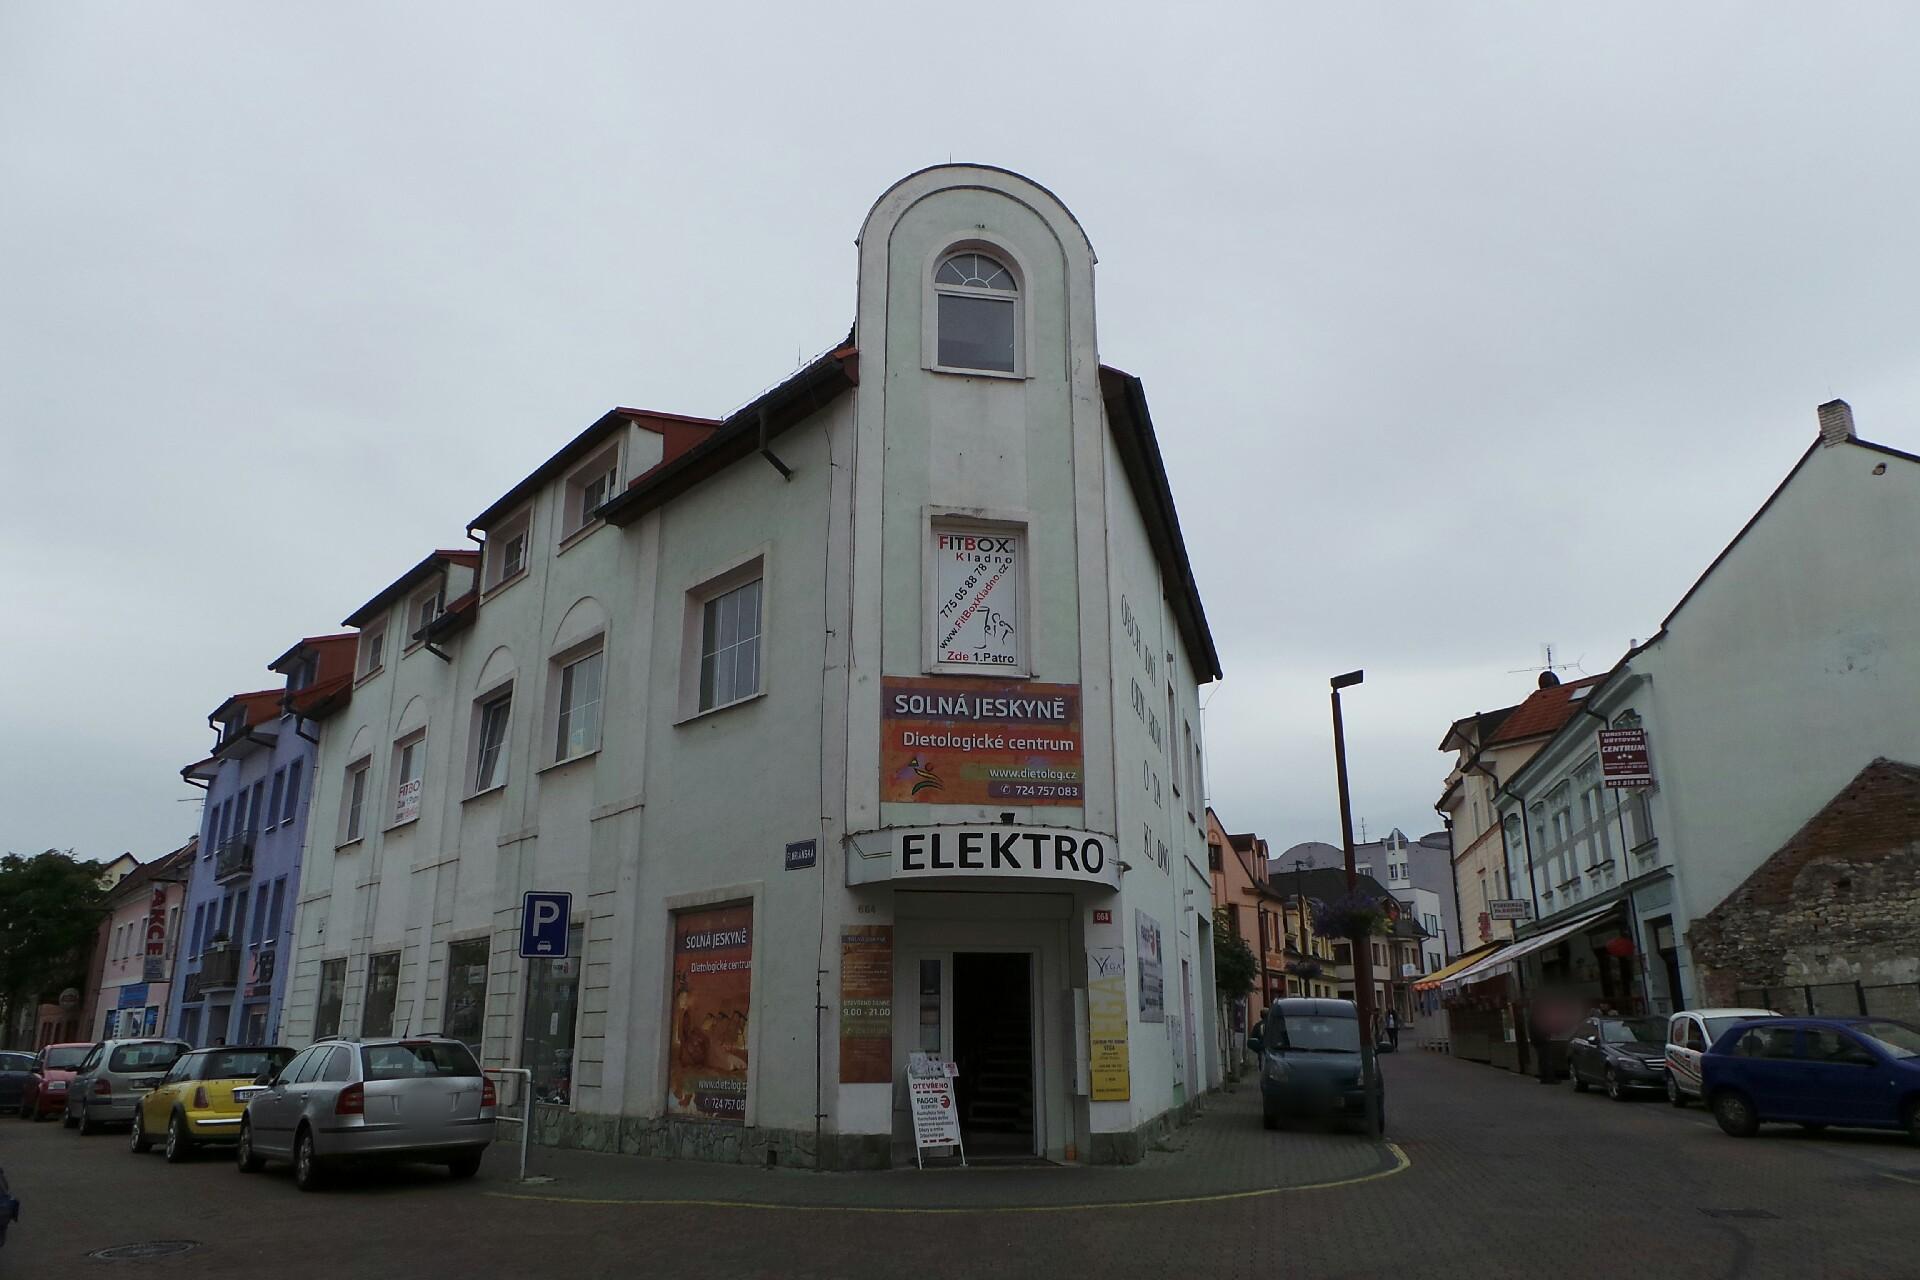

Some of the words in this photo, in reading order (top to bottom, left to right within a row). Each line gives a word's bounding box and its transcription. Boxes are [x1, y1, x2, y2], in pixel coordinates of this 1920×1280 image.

[956, 552, 1012, 564] Kladno
[940, 600, 958, 618] 775
[955, 587, 968, 601] 05
[964, 575, 977, 588] 88
[974, 563, 987, 576] 78
[947, 651, 969, 661] Zde
[974, 652, 1015, 664] 1.Patro
[895, 693, 969, 715] SOLNÁ
[973, 697, 1065, 719] JESKYNĚ
[903, 731, 1004, 751] Dietologické
[1008, 737, 1074, 751] centrum
[990, 769, 1076, 781] www.dietolog.cz
[1015, 785, 1034, 795] 724
[1037, 786, 1055, 796] 757
[1057, 786, 1078, 797] 083
[902, 832, 1104, 874] ELEKTRO
[147, 889, 166, 956] AKCE
[533, 900, 560, 937] P
[1096, 912, 1109, 921] 664
[686, 932, 710, 949] SOLNÁ
[712, 927, 747, 948] JESKYNĚ
[691, 960, 727, 974] Dietologické
[736, 1099, 745, 1111] 08
